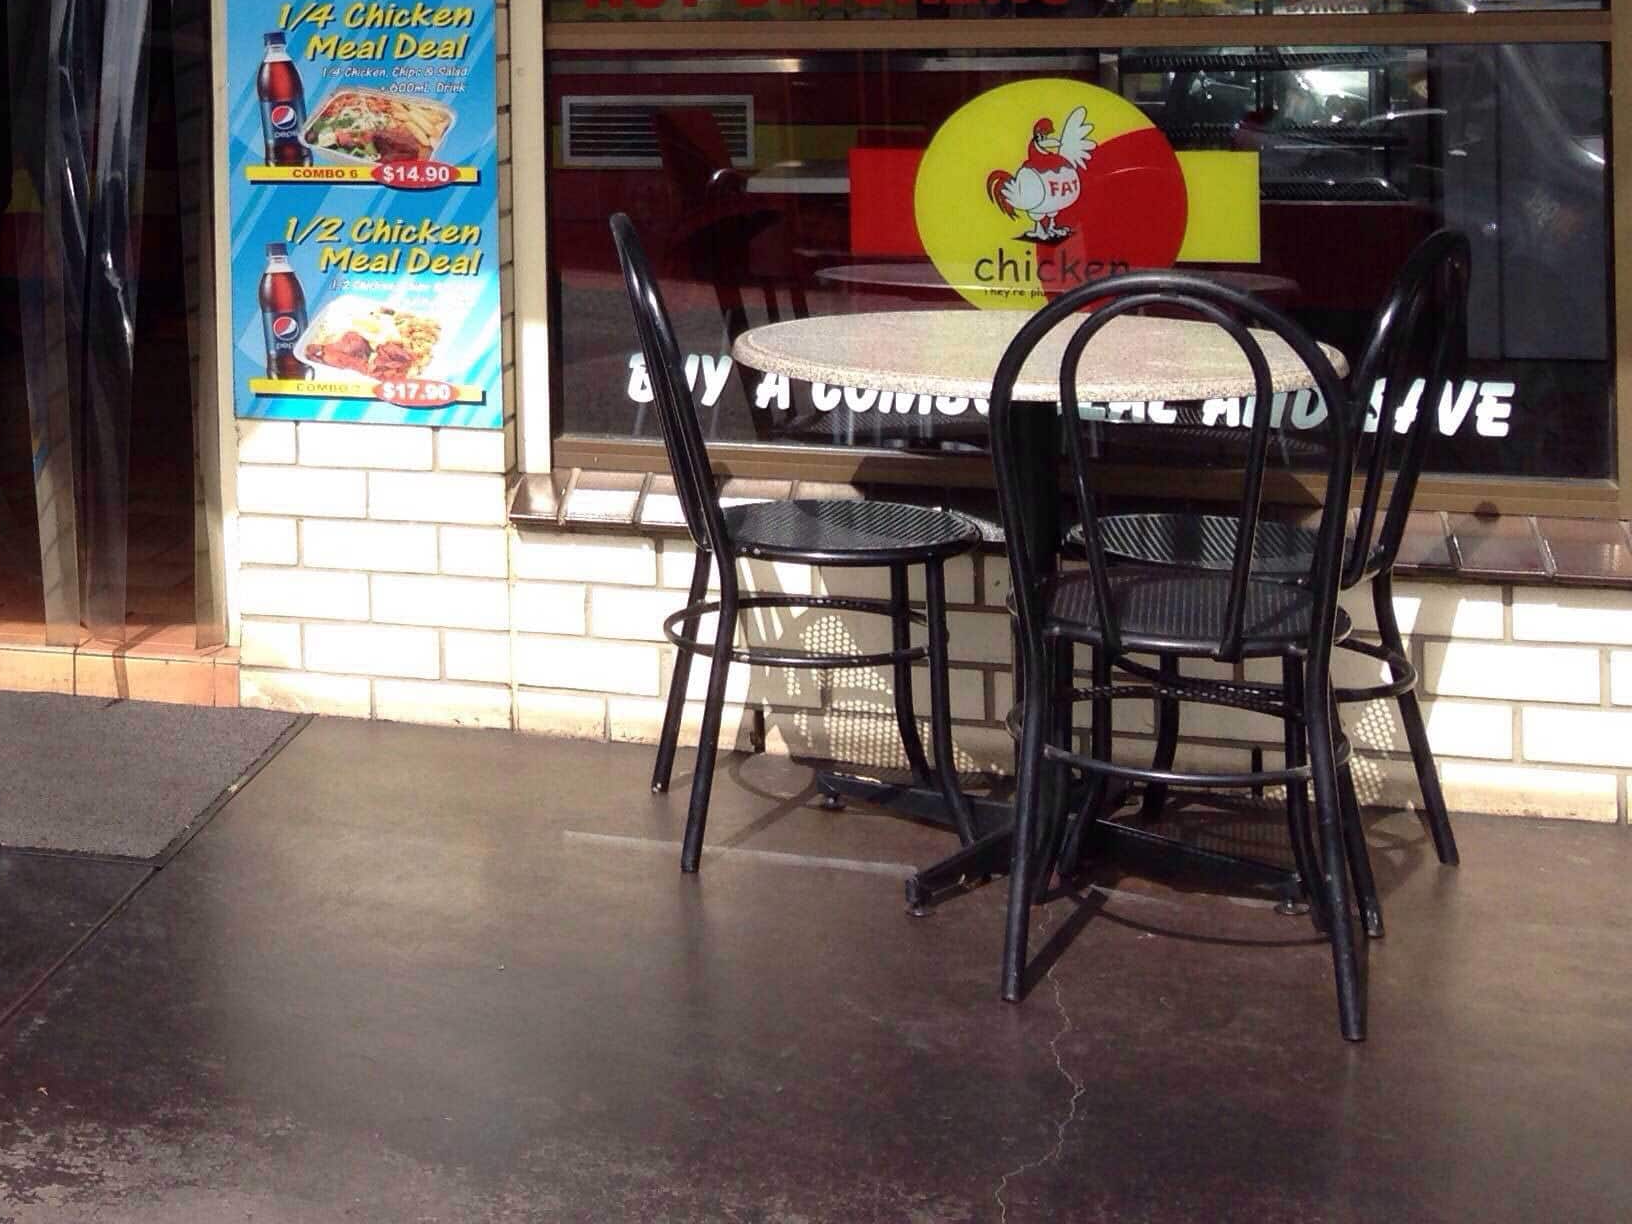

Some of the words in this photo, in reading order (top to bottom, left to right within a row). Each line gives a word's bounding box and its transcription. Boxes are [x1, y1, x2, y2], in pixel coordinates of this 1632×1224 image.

[277, 2, 336, 32] 1/4
[344, 1, 476, 29] Chicken
[305, 32, 386, 62] Meal
[393, 32, 471, 61] Deal
[437, 82, 465, 93] Drink
[293, 169, 345, 178] COMBO
[383, 166, 450, 183] $14.90
[285, 217, 344, 245] 1/2
[350, 216, 482, 246] Chicken
[319, 247, 405, 275] Meal
[407, 248, 483, 276] Deal
[974, 247, 1129, 283] chicken
[383, 383, 450, 400] $17.90
